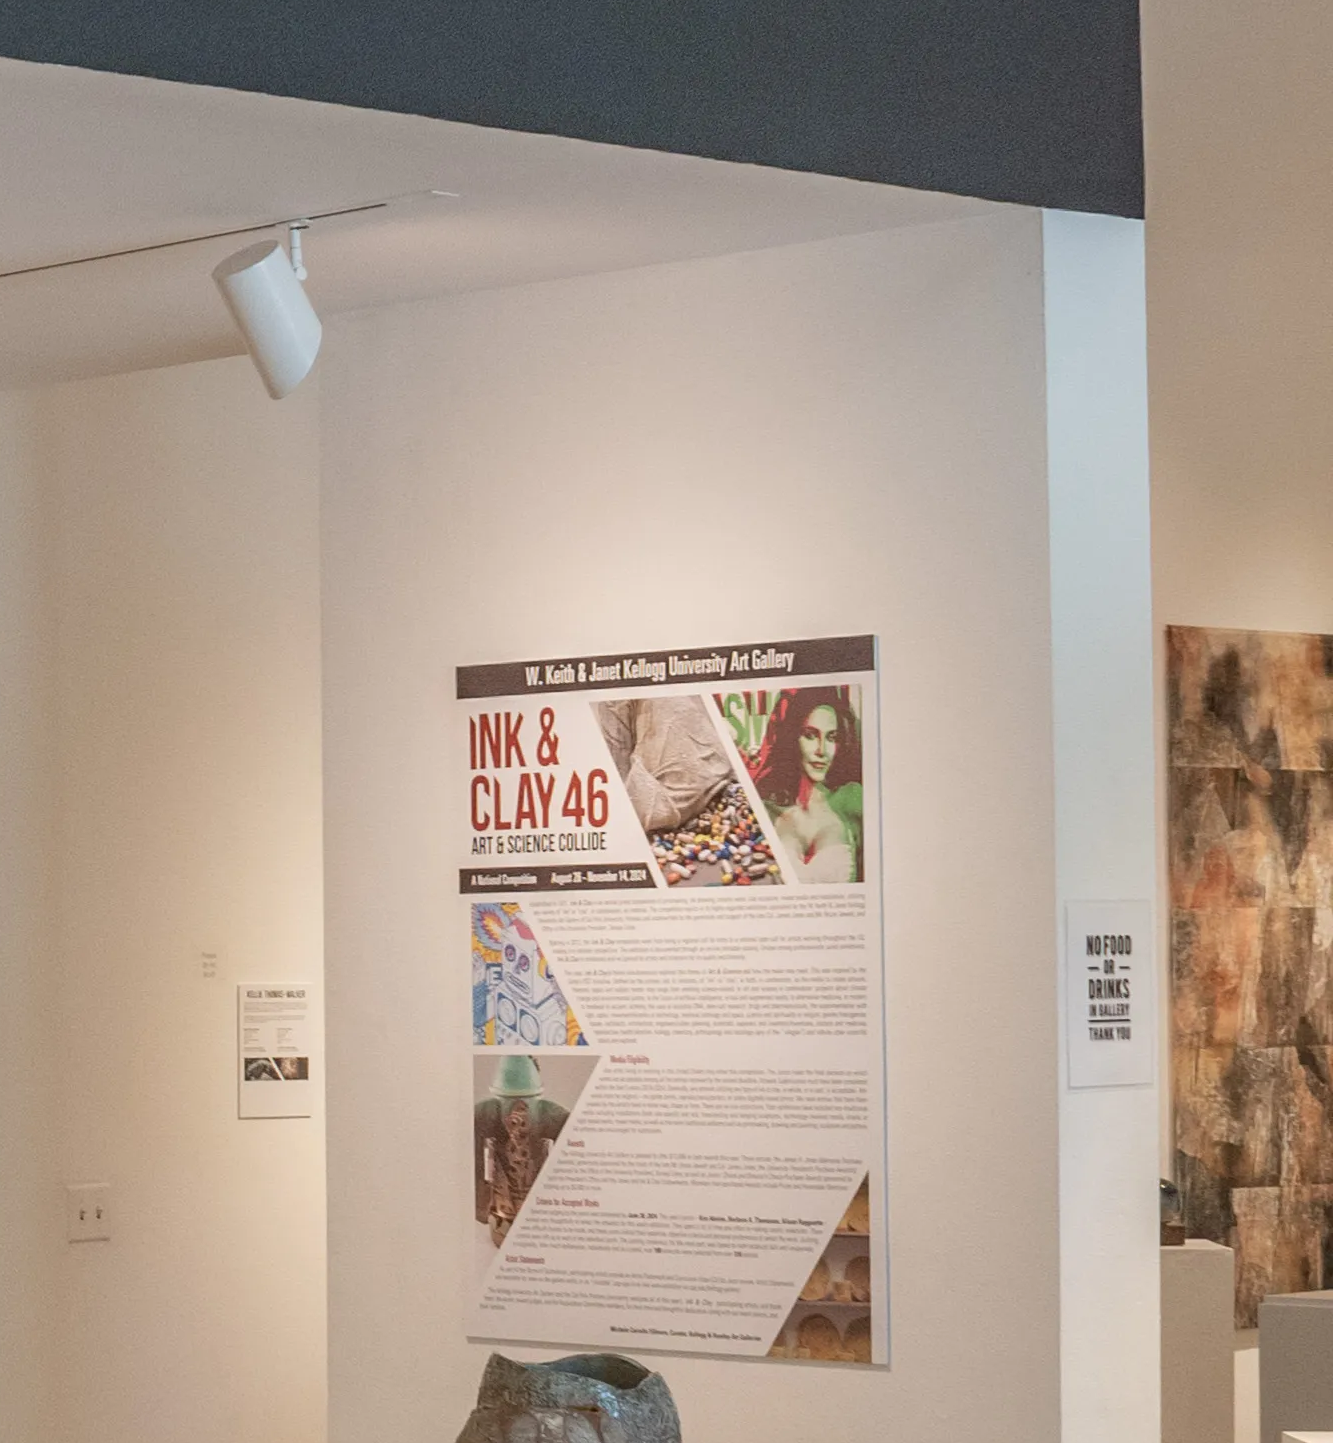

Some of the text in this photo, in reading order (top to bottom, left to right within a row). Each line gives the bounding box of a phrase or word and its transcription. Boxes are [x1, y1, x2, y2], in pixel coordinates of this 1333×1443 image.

[525, 648, 795, 686] W. Keith & Janet Kellogg University Art Gallery
[469, 706, 560, 770] INK &
[471, 768, 609, 832] CLAY 46
[471, 832, 607, 855] ART & SCIENCE COLLIDE
[1086, 934, 1132, 956] NO FOOD
[1103, 959, 1115, 975] OR
[1088, 978, 1130, 1000] DRINKS
[1089, 1003, 1130, 1017] IN GALLERY
[1089, 1026, 1131, 1041] THANK YOU
